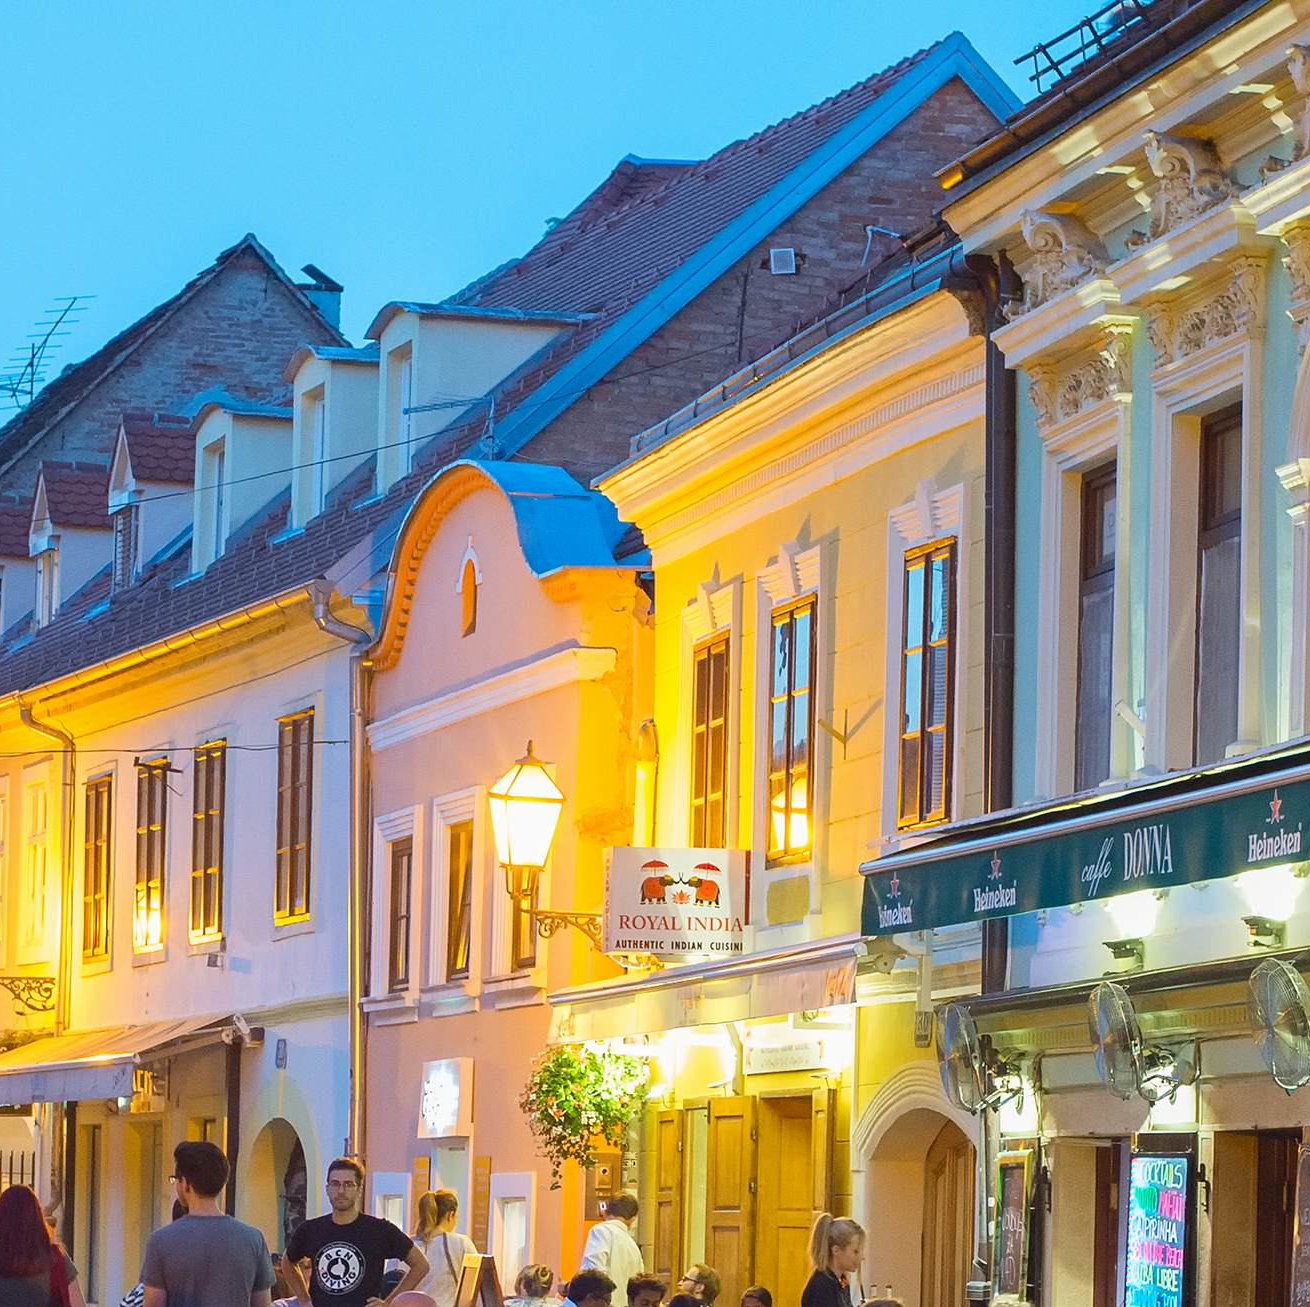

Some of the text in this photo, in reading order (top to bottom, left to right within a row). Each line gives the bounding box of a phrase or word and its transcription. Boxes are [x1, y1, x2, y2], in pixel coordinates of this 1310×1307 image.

[1248, 826, 1302, 862] Heineken
[1082, 824, 1173, 896] caffe DONNA
[973, 882, 1017, 912] Heineken
[619, 915, 744, 932] ROYAL INDIA
[615, 939, 664, 950] AUTHENTIC
[671, 941, 703, 950] INDIAN
[325, 1250, 353, 1260] BCN
[322, 1272, 356, 1288] DIVING
[1157, 1267, 1179, 1292] LIBRE
